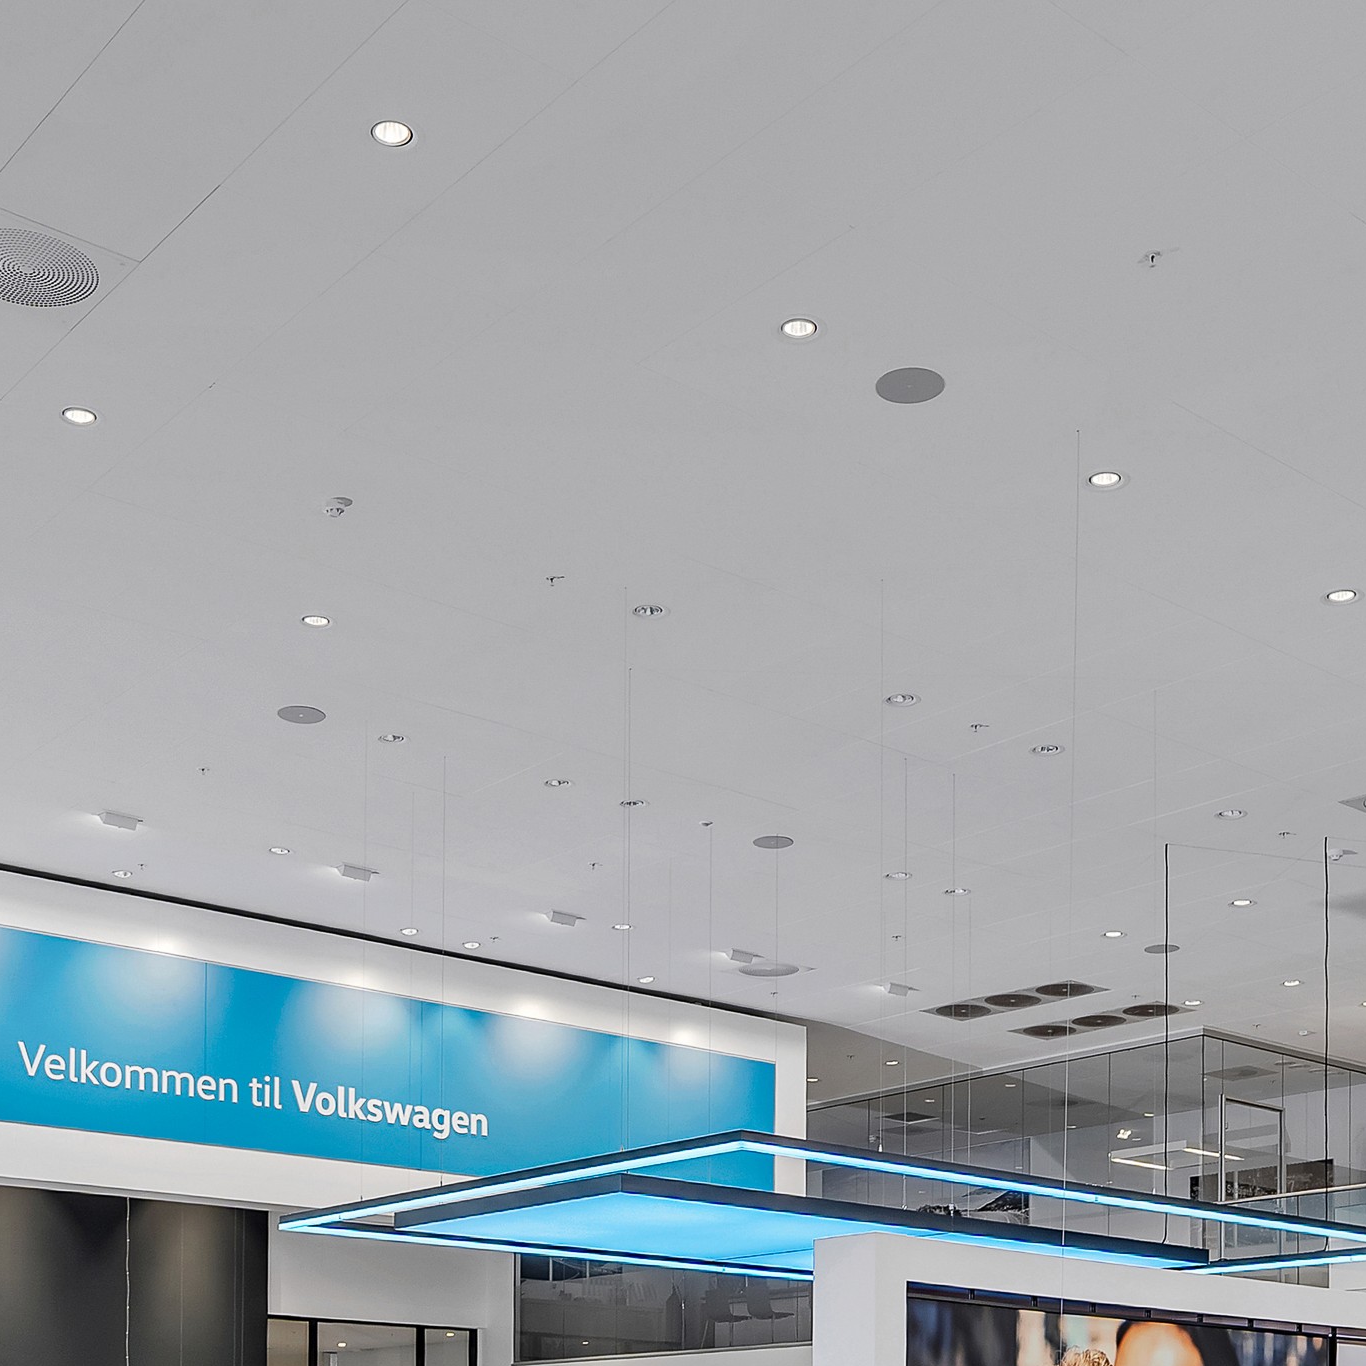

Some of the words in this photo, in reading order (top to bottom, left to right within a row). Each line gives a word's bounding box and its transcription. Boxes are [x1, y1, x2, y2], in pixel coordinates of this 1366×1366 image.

[18, 1041, 238, 1103] Velkommen
[249, 1075, 282, 1110] til
[292, 1079, 488, 1140] Volkswagen
